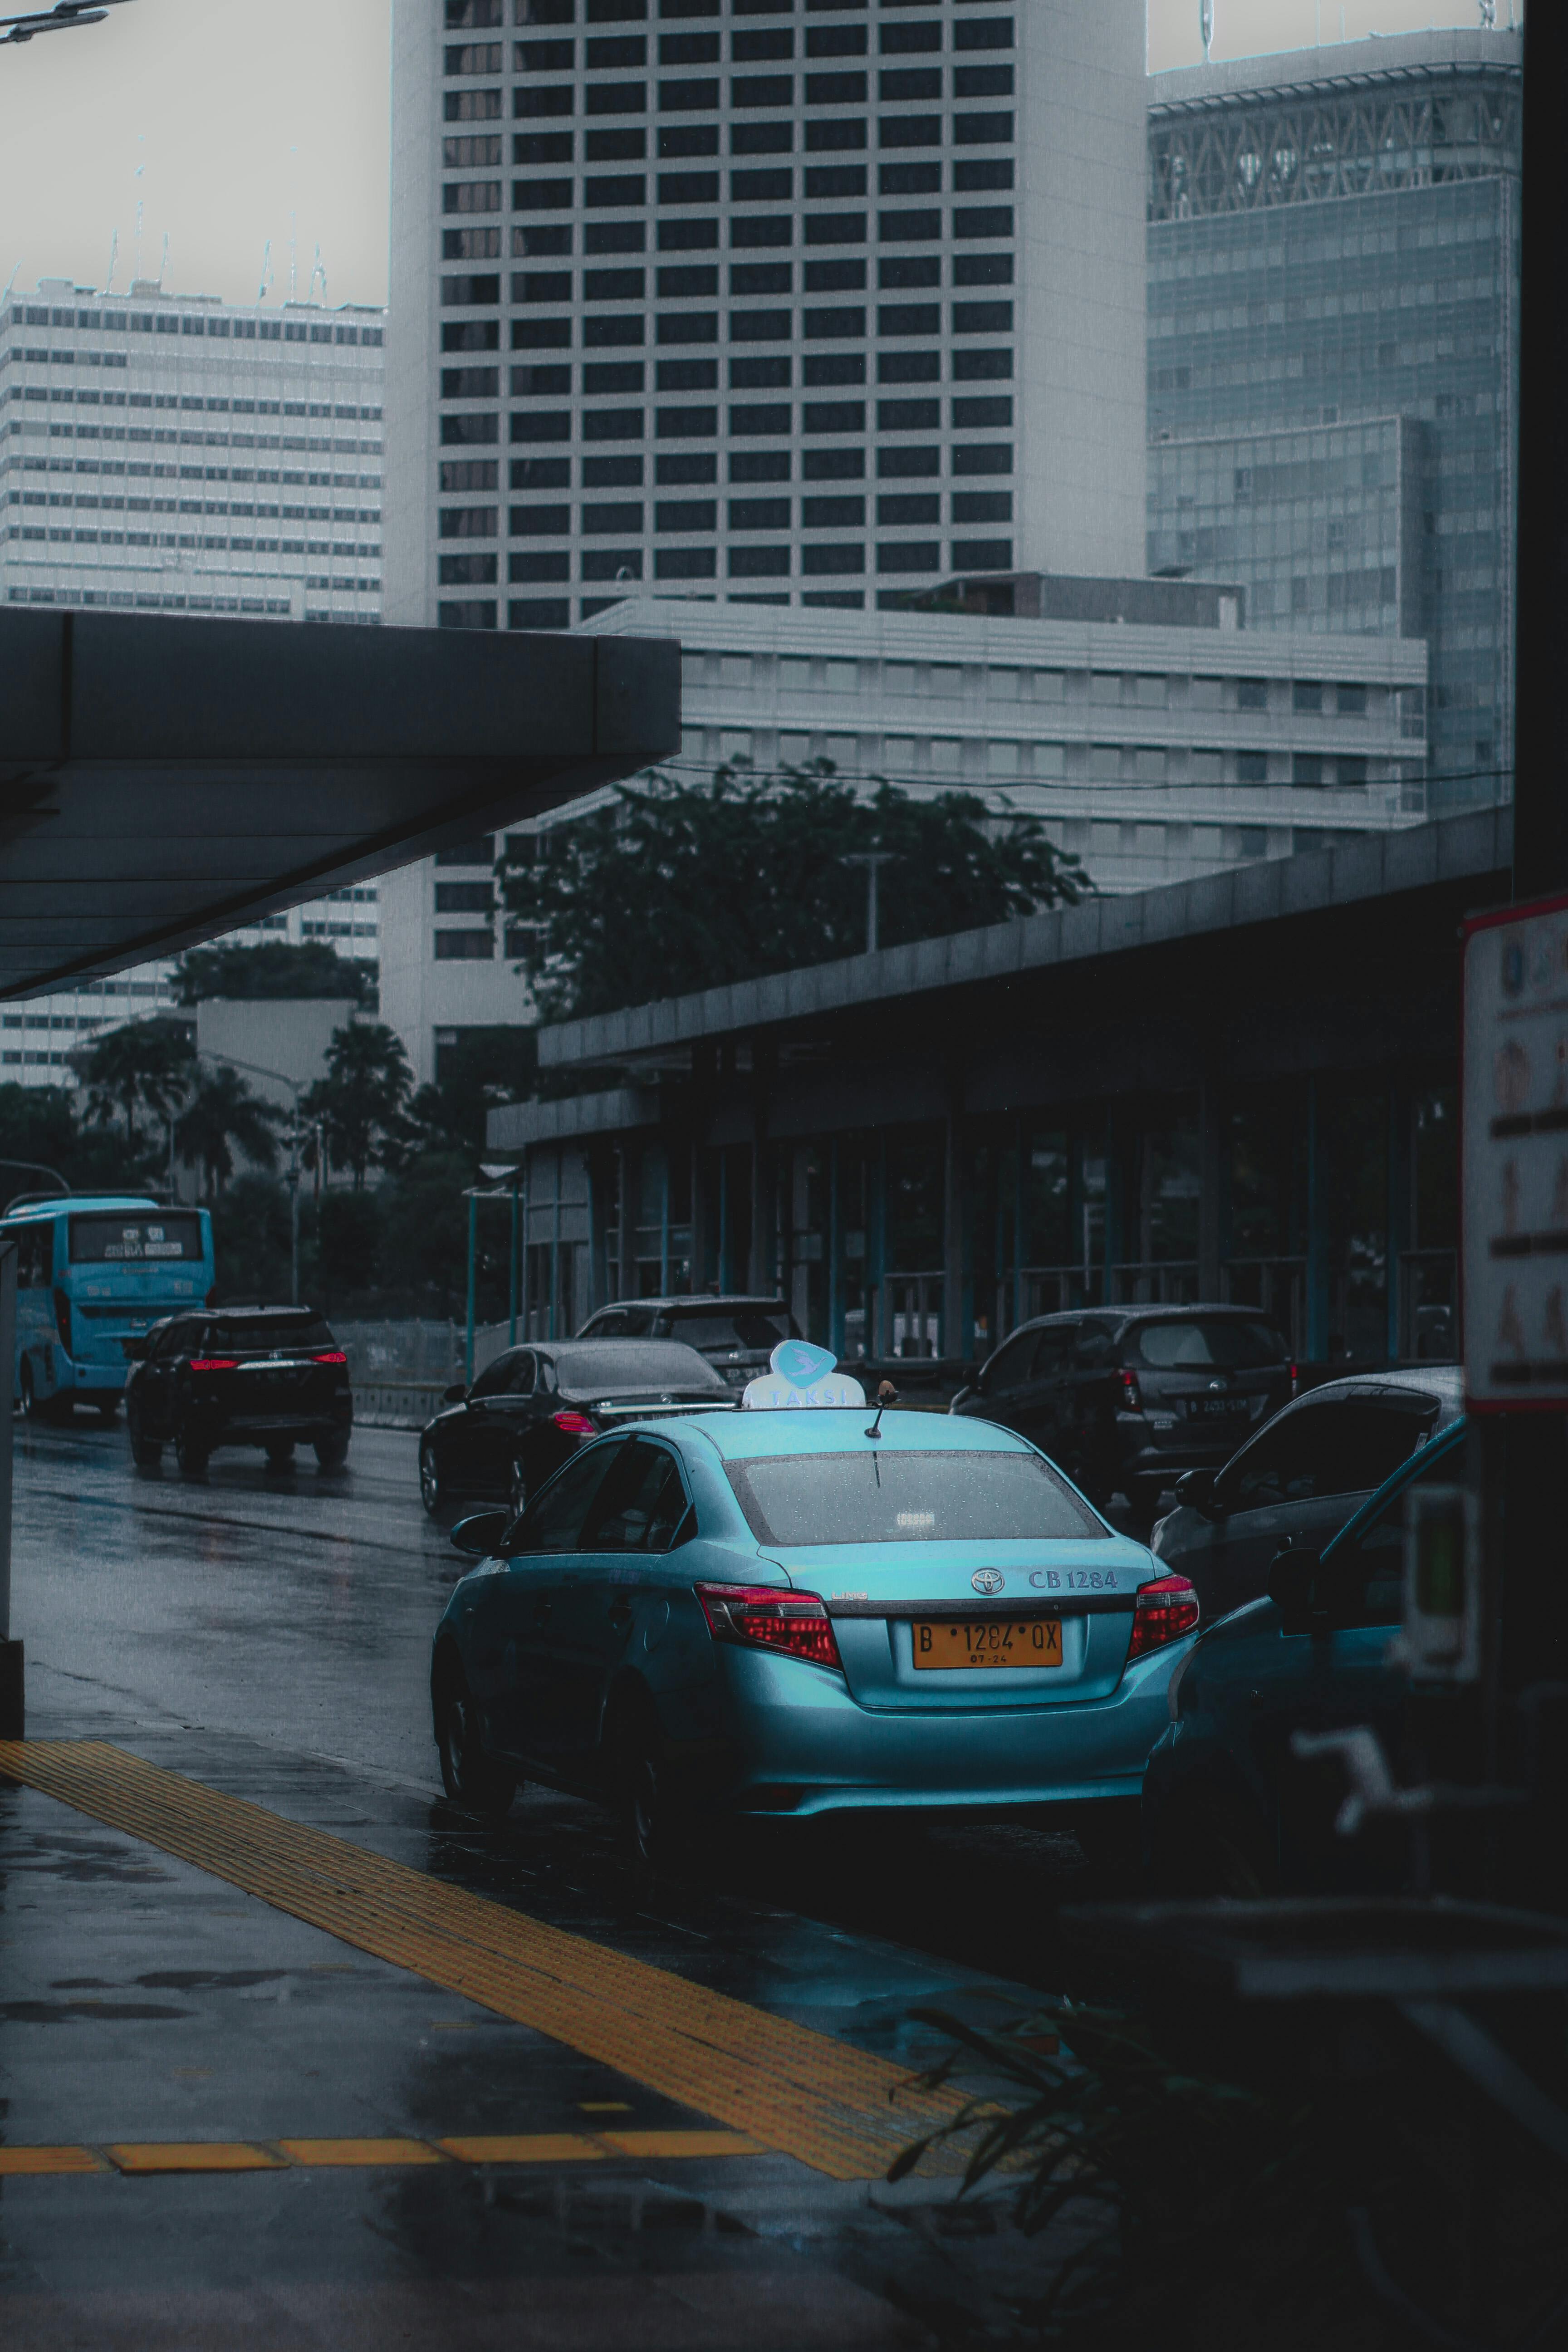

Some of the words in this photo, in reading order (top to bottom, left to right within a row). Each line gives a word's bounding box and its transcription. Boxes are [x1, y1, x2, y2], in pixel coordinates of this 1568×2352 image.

[769, 1390, 846, 1405] TAKSI
[1029, 1571, 1061, 1588] CB
[1066, 1571, 1117, 1588] 1284
[920, 1626, 932, 1651] B
[963, 1624, 1013, 1651] 1284
[1032, 1623, 1057, 1649] QX
